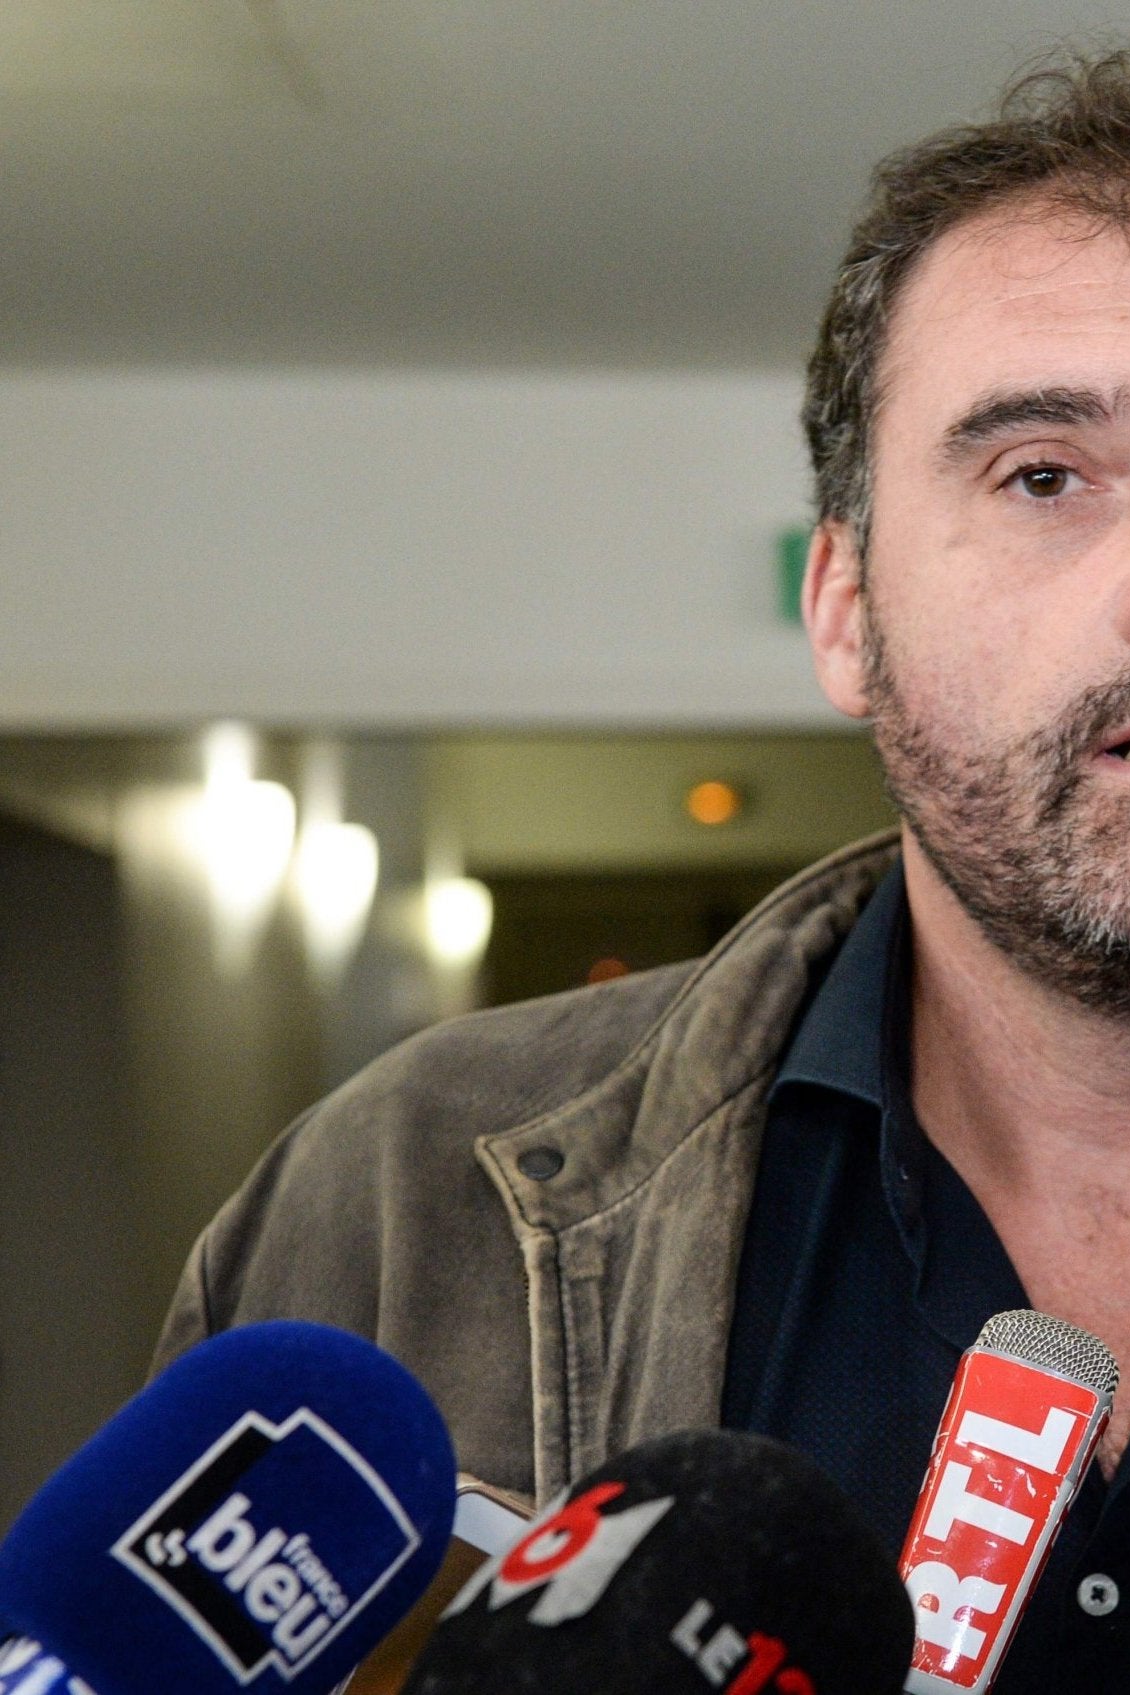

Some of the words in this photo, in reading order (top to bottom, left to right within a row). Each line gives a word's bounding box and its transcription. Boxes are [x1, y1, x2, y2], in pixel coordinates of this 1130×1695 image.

[186, 1492, 332, 1662] bleu
[281, 1532, 349, 1618] france
[904, 1406, 1077, 1660] RTL
